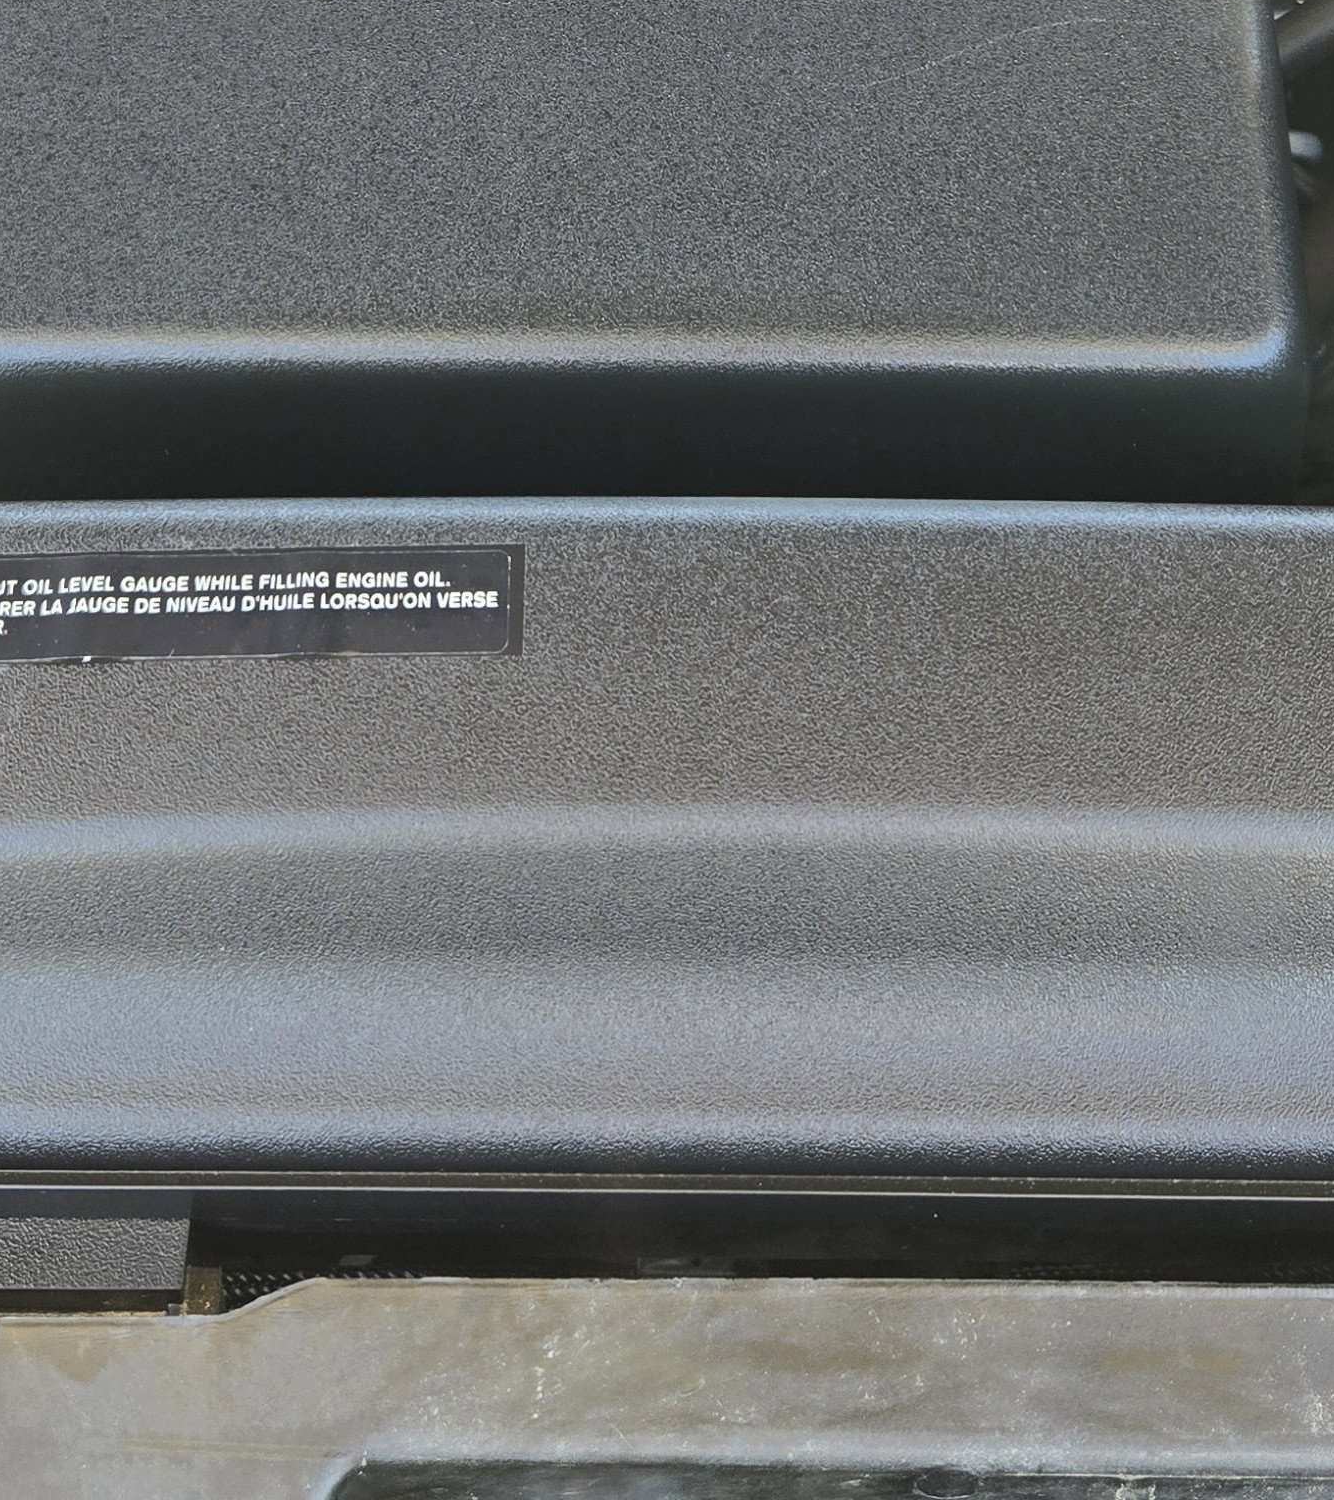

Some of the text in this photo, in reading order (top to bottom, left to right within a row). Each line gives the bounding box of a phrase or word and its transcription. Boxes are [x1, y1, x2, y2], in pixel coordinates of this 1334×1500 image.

[21, 578, 53, 595] OIL
[58, 576, 115, 594] LEVEL
[120, 575, 189, 593] GAUGE
[194, 574, 253, 591] WHILE
[259, 572, 330, 590] FILLING
[335, 571, 408, 588] ENGINE
[413, 571, 451, 588] OIL.
[40, 599, 63, 617] LA
[66, 597, 129, 616] JAUGE
[134, 597, 161, 614] DE
[166, 595, 236, 613] NIVEAU
[241, 593, 315, 611] D'HUILE
[320, 592, 432, 609] LORSQU'ON
[436, 591, 499, 609] VERSE
